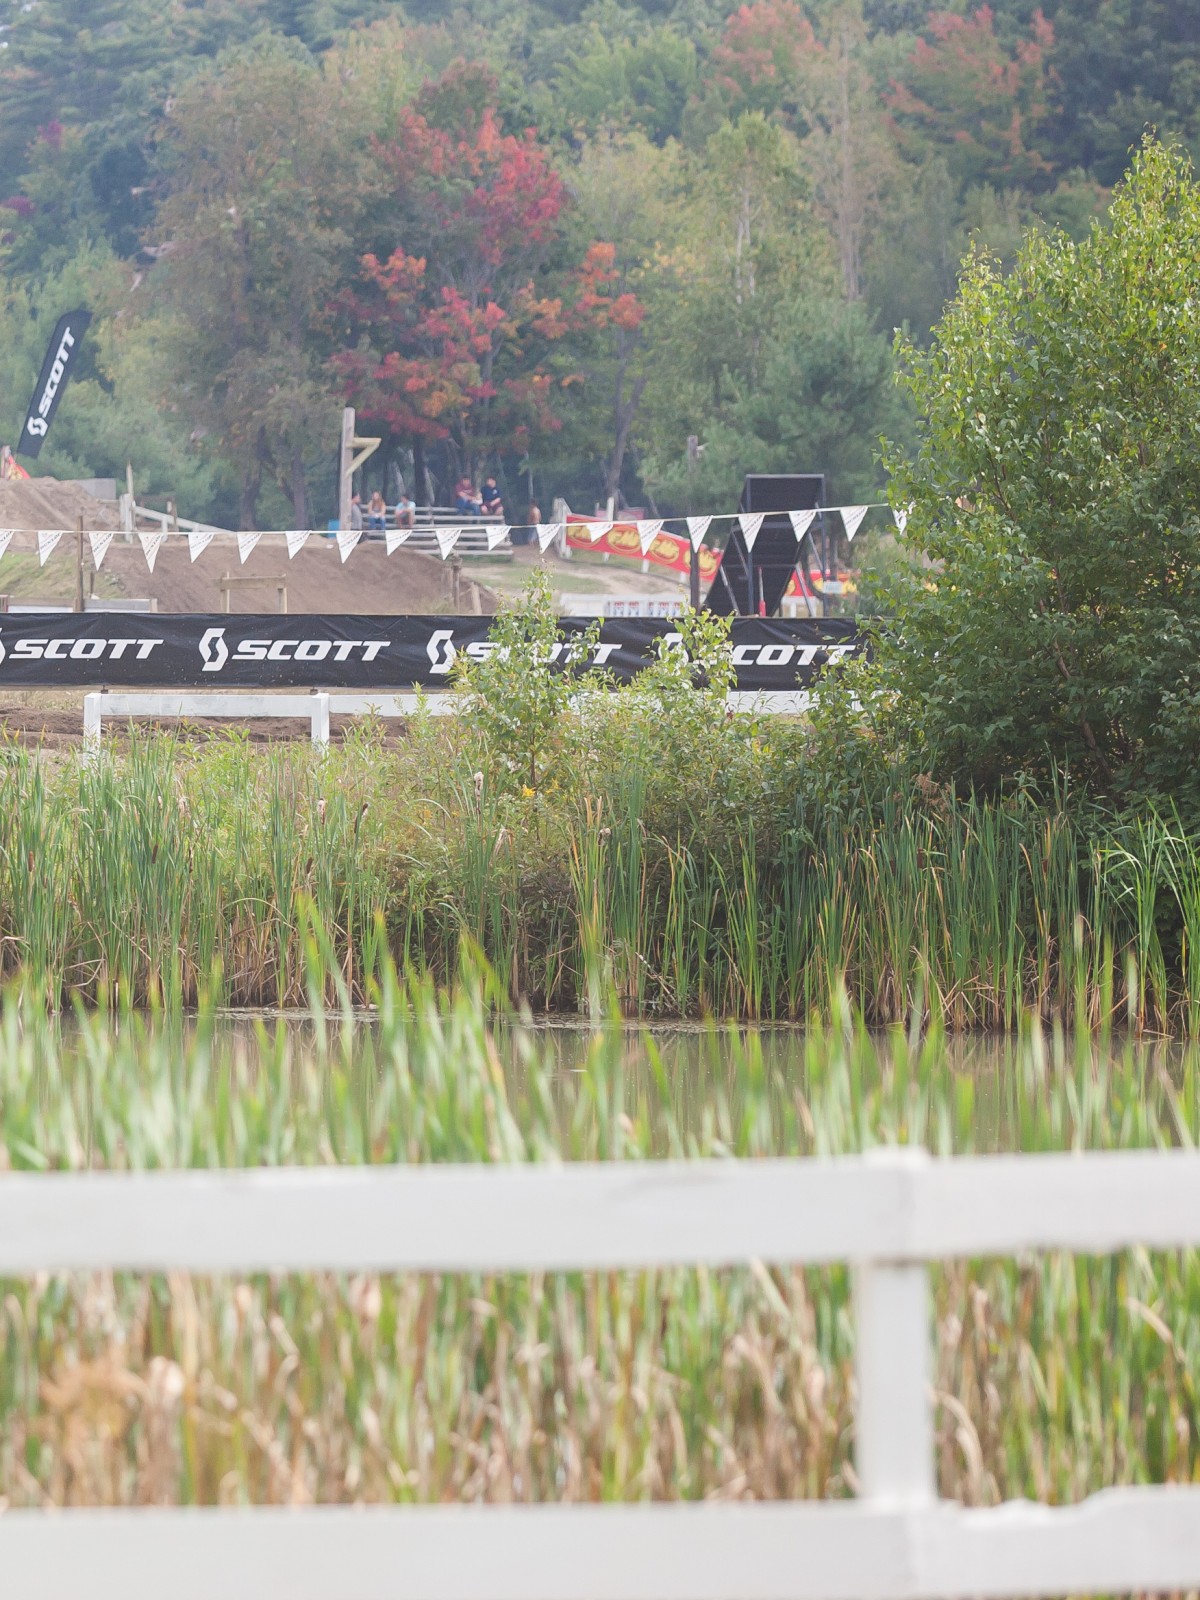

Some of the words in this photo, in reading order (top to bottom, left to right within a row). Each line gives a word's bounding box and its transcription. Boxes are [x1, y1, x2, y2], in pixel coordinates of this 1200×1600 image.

[38, 326, 76, 419] SCOTT
[9, 638, 164, 659] SCOTT
[231, 639, 392, 661] SCOTT
